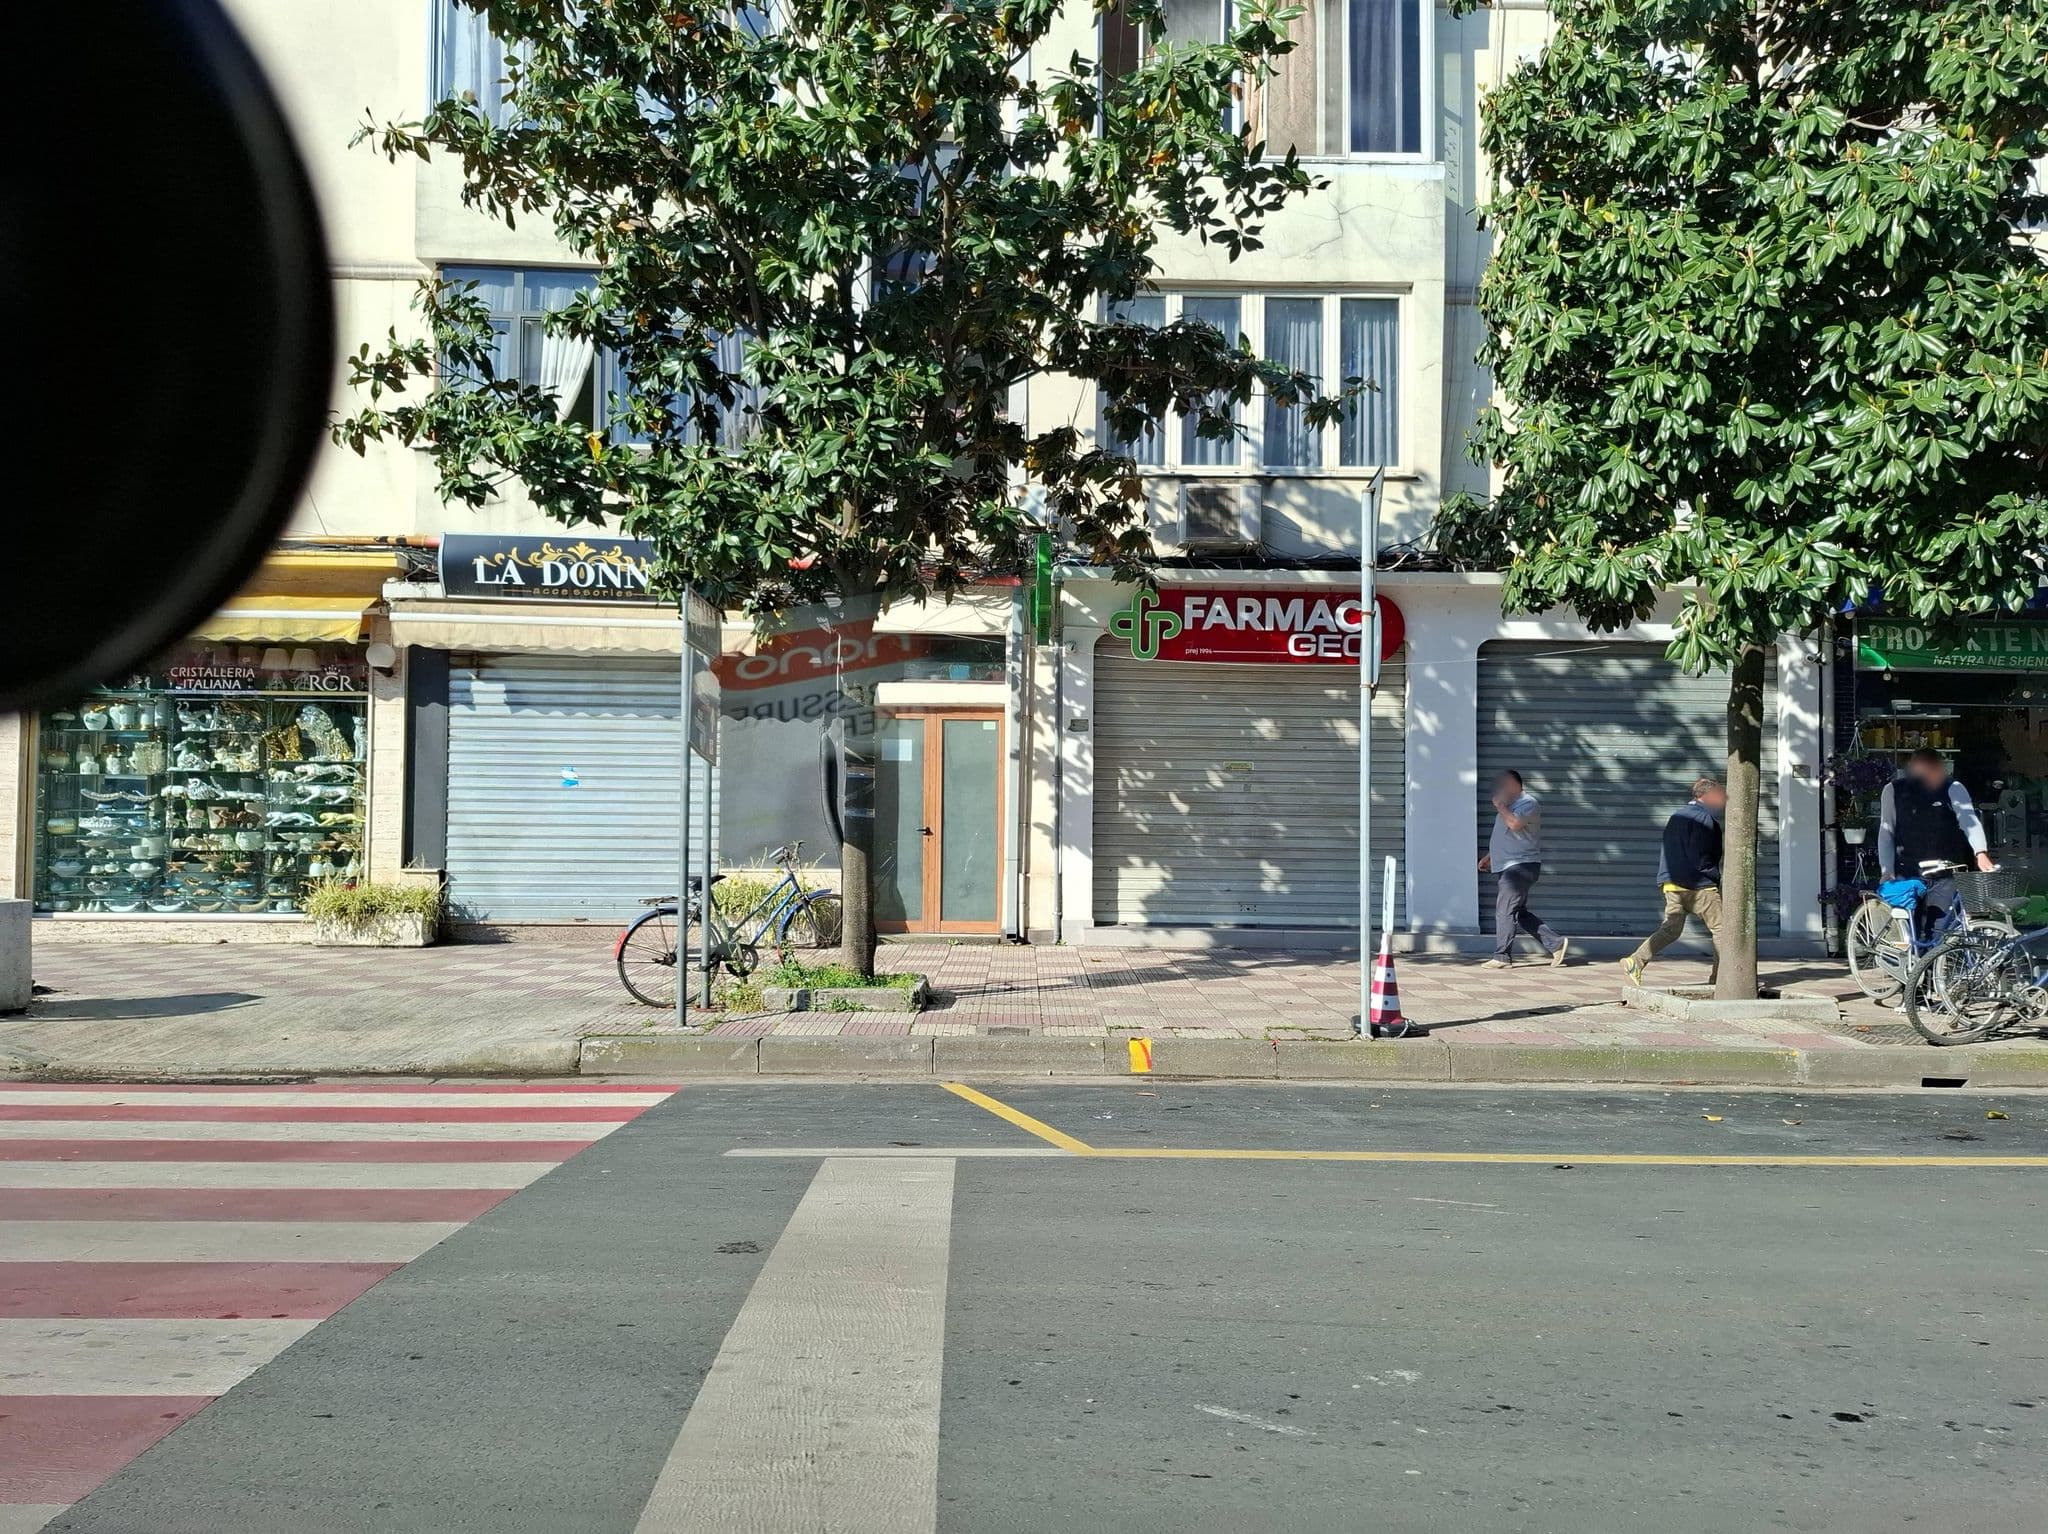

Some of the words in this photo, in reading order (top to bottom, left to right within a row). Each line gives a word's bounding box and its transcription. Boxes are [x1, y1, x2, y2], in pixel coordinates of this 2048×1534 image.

[473, 558, 526, 586] LA
[541, 560, 653, 589] DONN
[1184, 597, 1363, 632] FARMAC
[1869, 625, 2022, 652] PROKTE
[1185, 648, 1199, 656] prej
[1933, 655, 1985, 666] NATYRA
[1988, 655, 2006, 666] NE
[170, 667, 256, 678] CRISTALLERIA
[183, 679, 242, 689] ITALIANA
[309, 674, 355, 692] RCR
